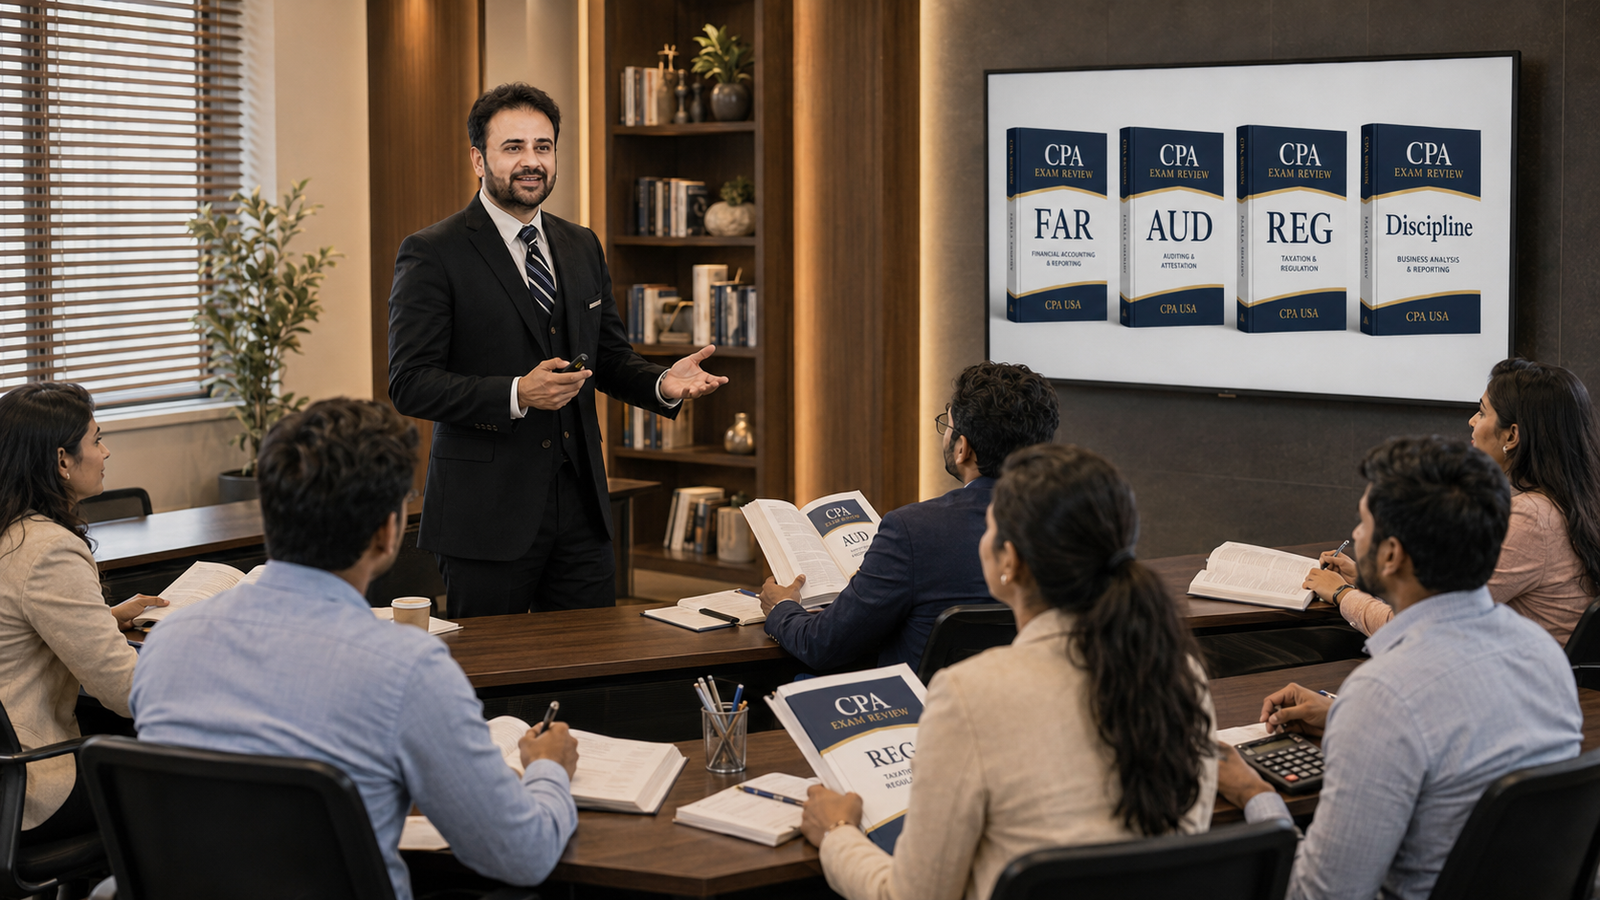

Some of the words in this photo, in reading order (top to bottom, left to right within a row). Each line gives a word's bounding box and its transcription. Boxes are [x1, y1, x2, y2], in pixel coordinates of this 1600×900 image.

[1045, 144, 1084, 167] CPA
[1159, 144, 1199, 167] CPA
[1279, 143, 1322, 166] CPA
[1406, 142, 1452, 165] CPA
[1035, 168, 1059, 178] EXAM
[1062, 169, 1093, 179] REVIEW
[1150, 169, 1174, 178] EXAM
[1177, 170, 1209, 179] REVIEW
[1268, 168, 1294, 178] EXAM
[1298, 169, 1332, 179] REVIEW
[1394, 168, 1422, 177] EXAM
[1427, 168, 1463, 179] REVIEW
[1034, 208, 1093, 240] FAR
[1146, 210, 1213, 241] AUD
[1267, 211, 1333, 244] REG
[1386, 214, 1473, 242] Discipline
[1397, 255, 1429, 263] BUSINESS
[1429, 256, 1460, 264] ANALYSIS
[1045, 300, 1062, 310] CPA
[1065, 300, 1081, 309] USA
[1160, 304, 1177, 314] CPA
[1180, 304, 1197, 313] USA
[1279, 308, 1298, 319] CPA
[1301, 308, 1319, 318] USA
[1406, 312, 1426, 322] CPA
[1429, 311, 1449, 321] USA
[825, 506, 852, 520] CPA
[842, 531, 869, 546] AUD
[834, 692, 892, 716] CPA
[830, 715, 865, 730] EXAM
[867, 707, 909, 722] REVIEW
[865, 742, 915, 768] REG
